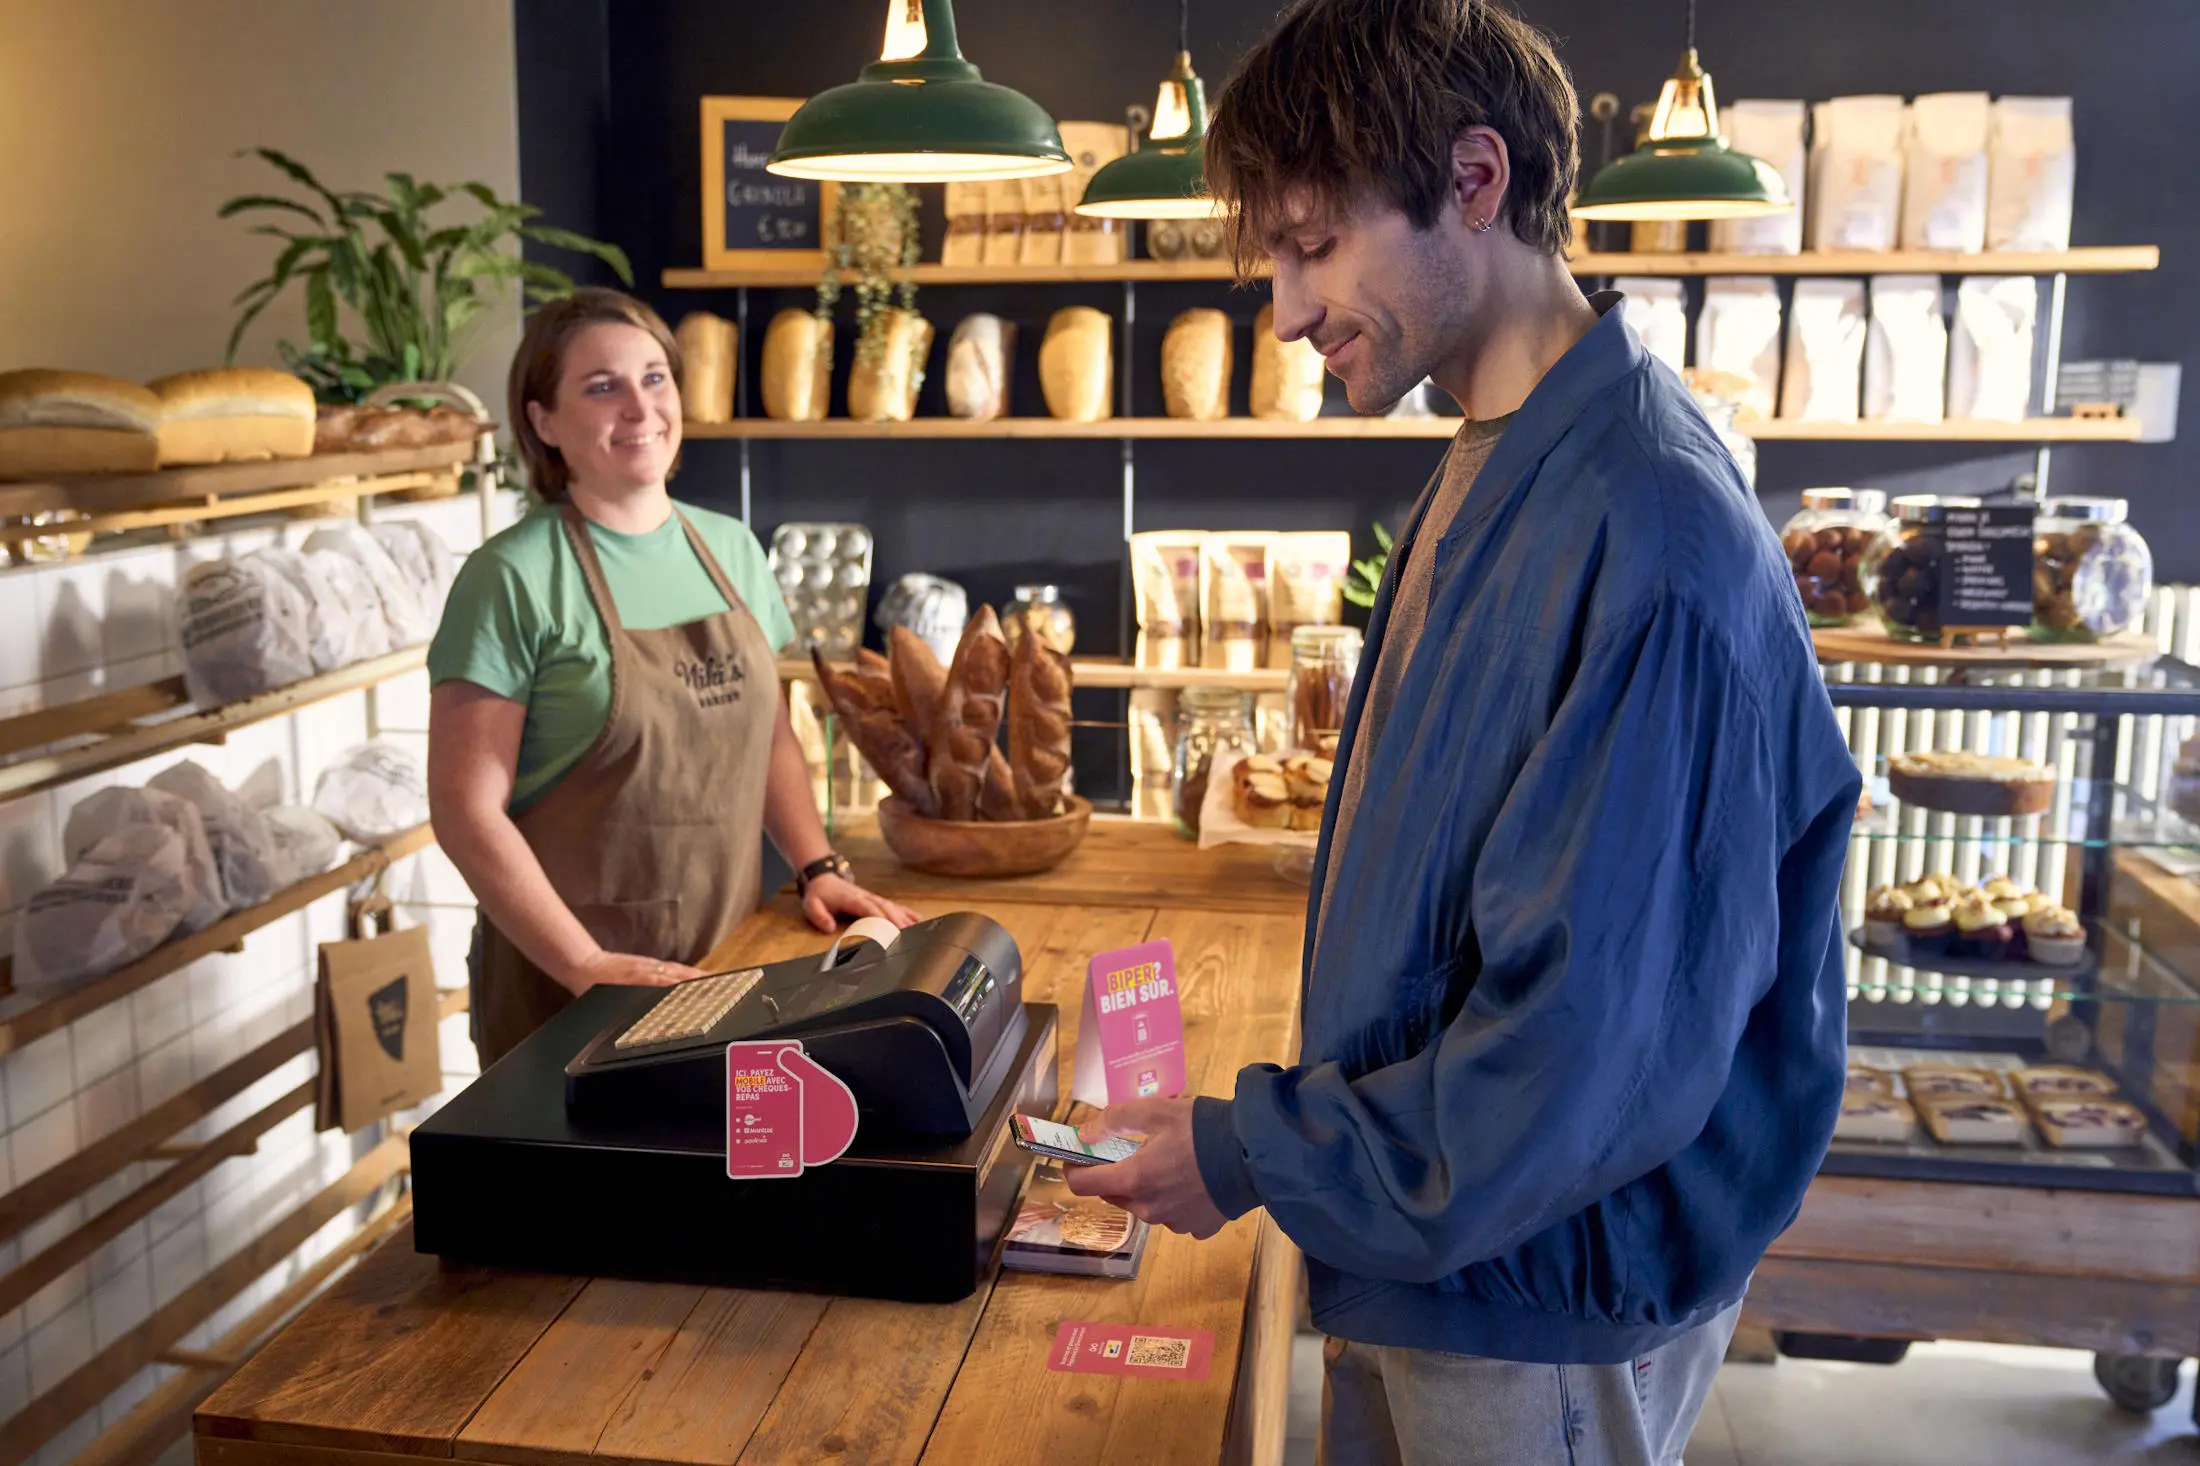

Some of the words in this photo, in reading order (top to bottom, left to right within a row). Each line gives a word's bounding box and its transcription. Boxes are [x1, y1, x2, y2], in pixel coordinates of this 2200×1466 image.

[1100, 988, 1136, 1014] BIEN
[750, 1069, 774, 1077] PAYEZ
[735, 1076, 766, 1085] MOBILE
